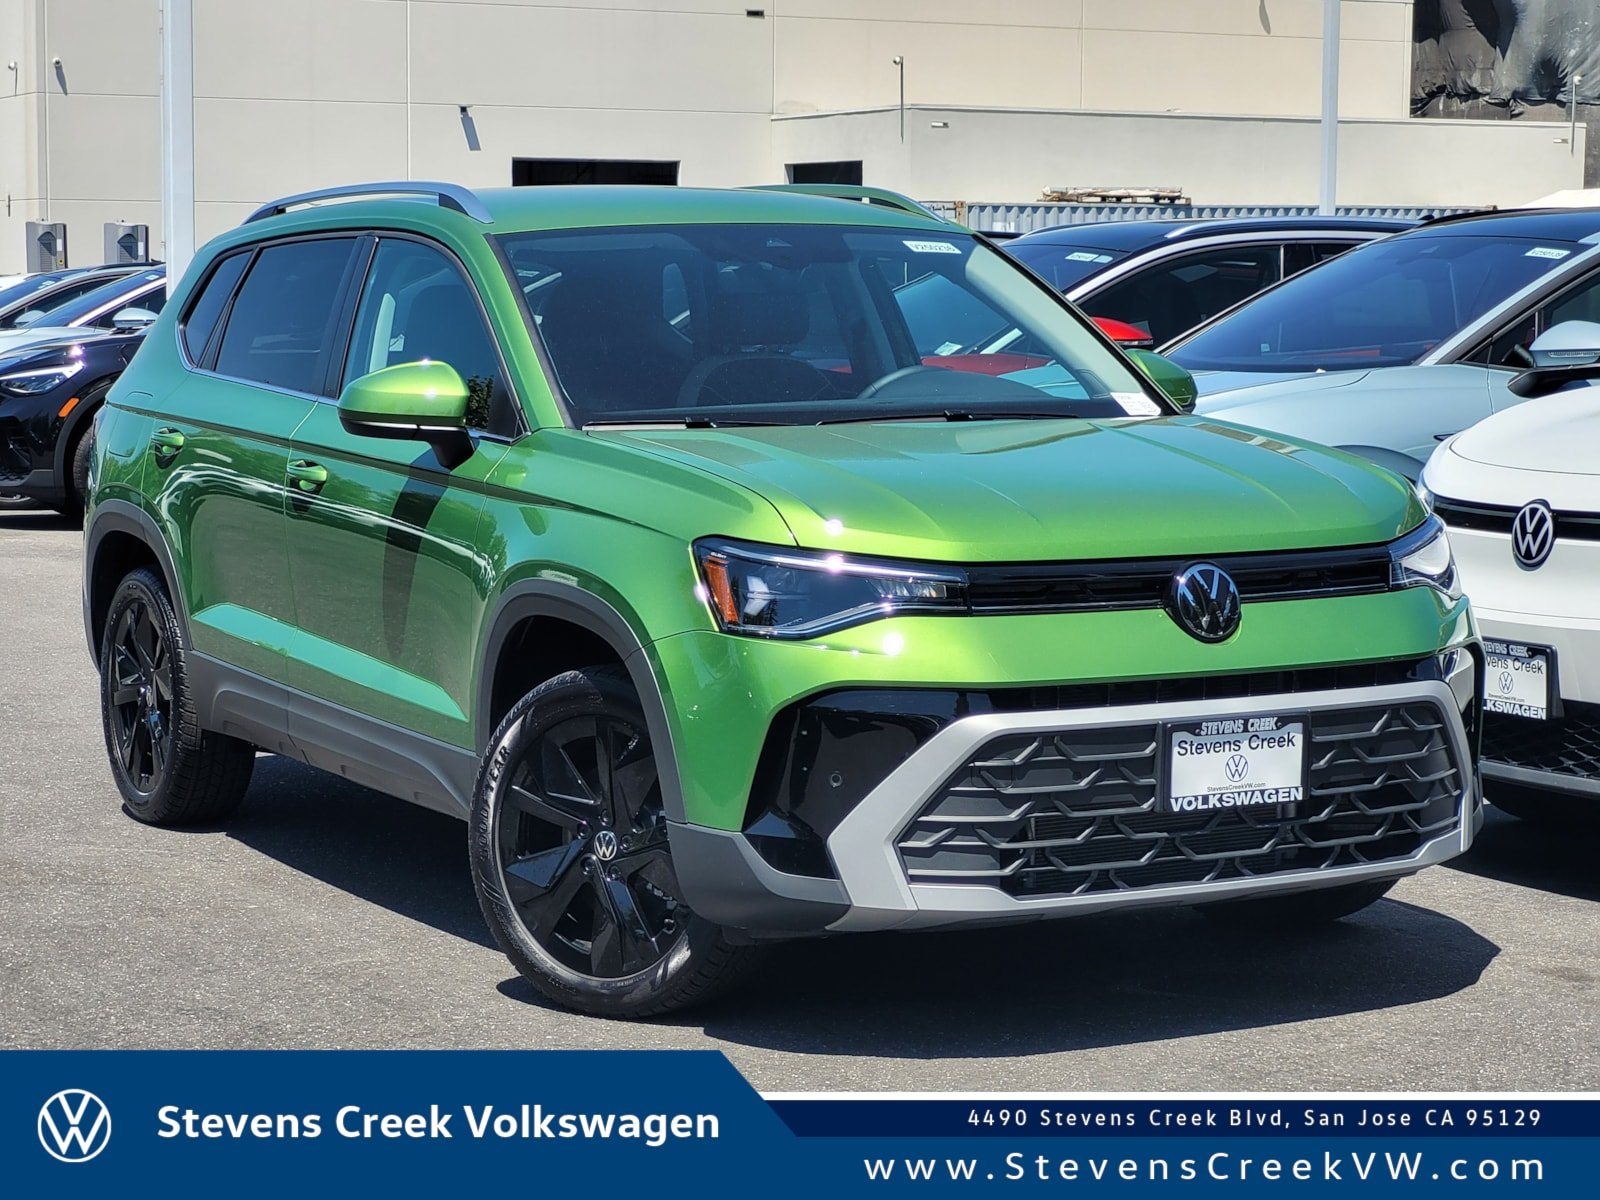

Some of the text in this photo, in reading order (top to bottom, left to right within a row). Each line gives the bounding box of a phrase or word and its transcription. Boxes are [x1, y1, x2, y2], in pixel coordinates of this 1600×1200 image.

[1509, 645, 1528, 657] CREEK
[1487, 656, 1543, 674] vens Creek
[1483, 700, 1546, 720] KSWAGEN
[1200, 717, 1278, 736] STEVENS CREEK
[1177, 732, 1296, 757] Stevens Creek
[1207, 782, 1266, 793] StevensCreekVW.com
[1170, 787, 1303, 812] VOLKSWAGEN
